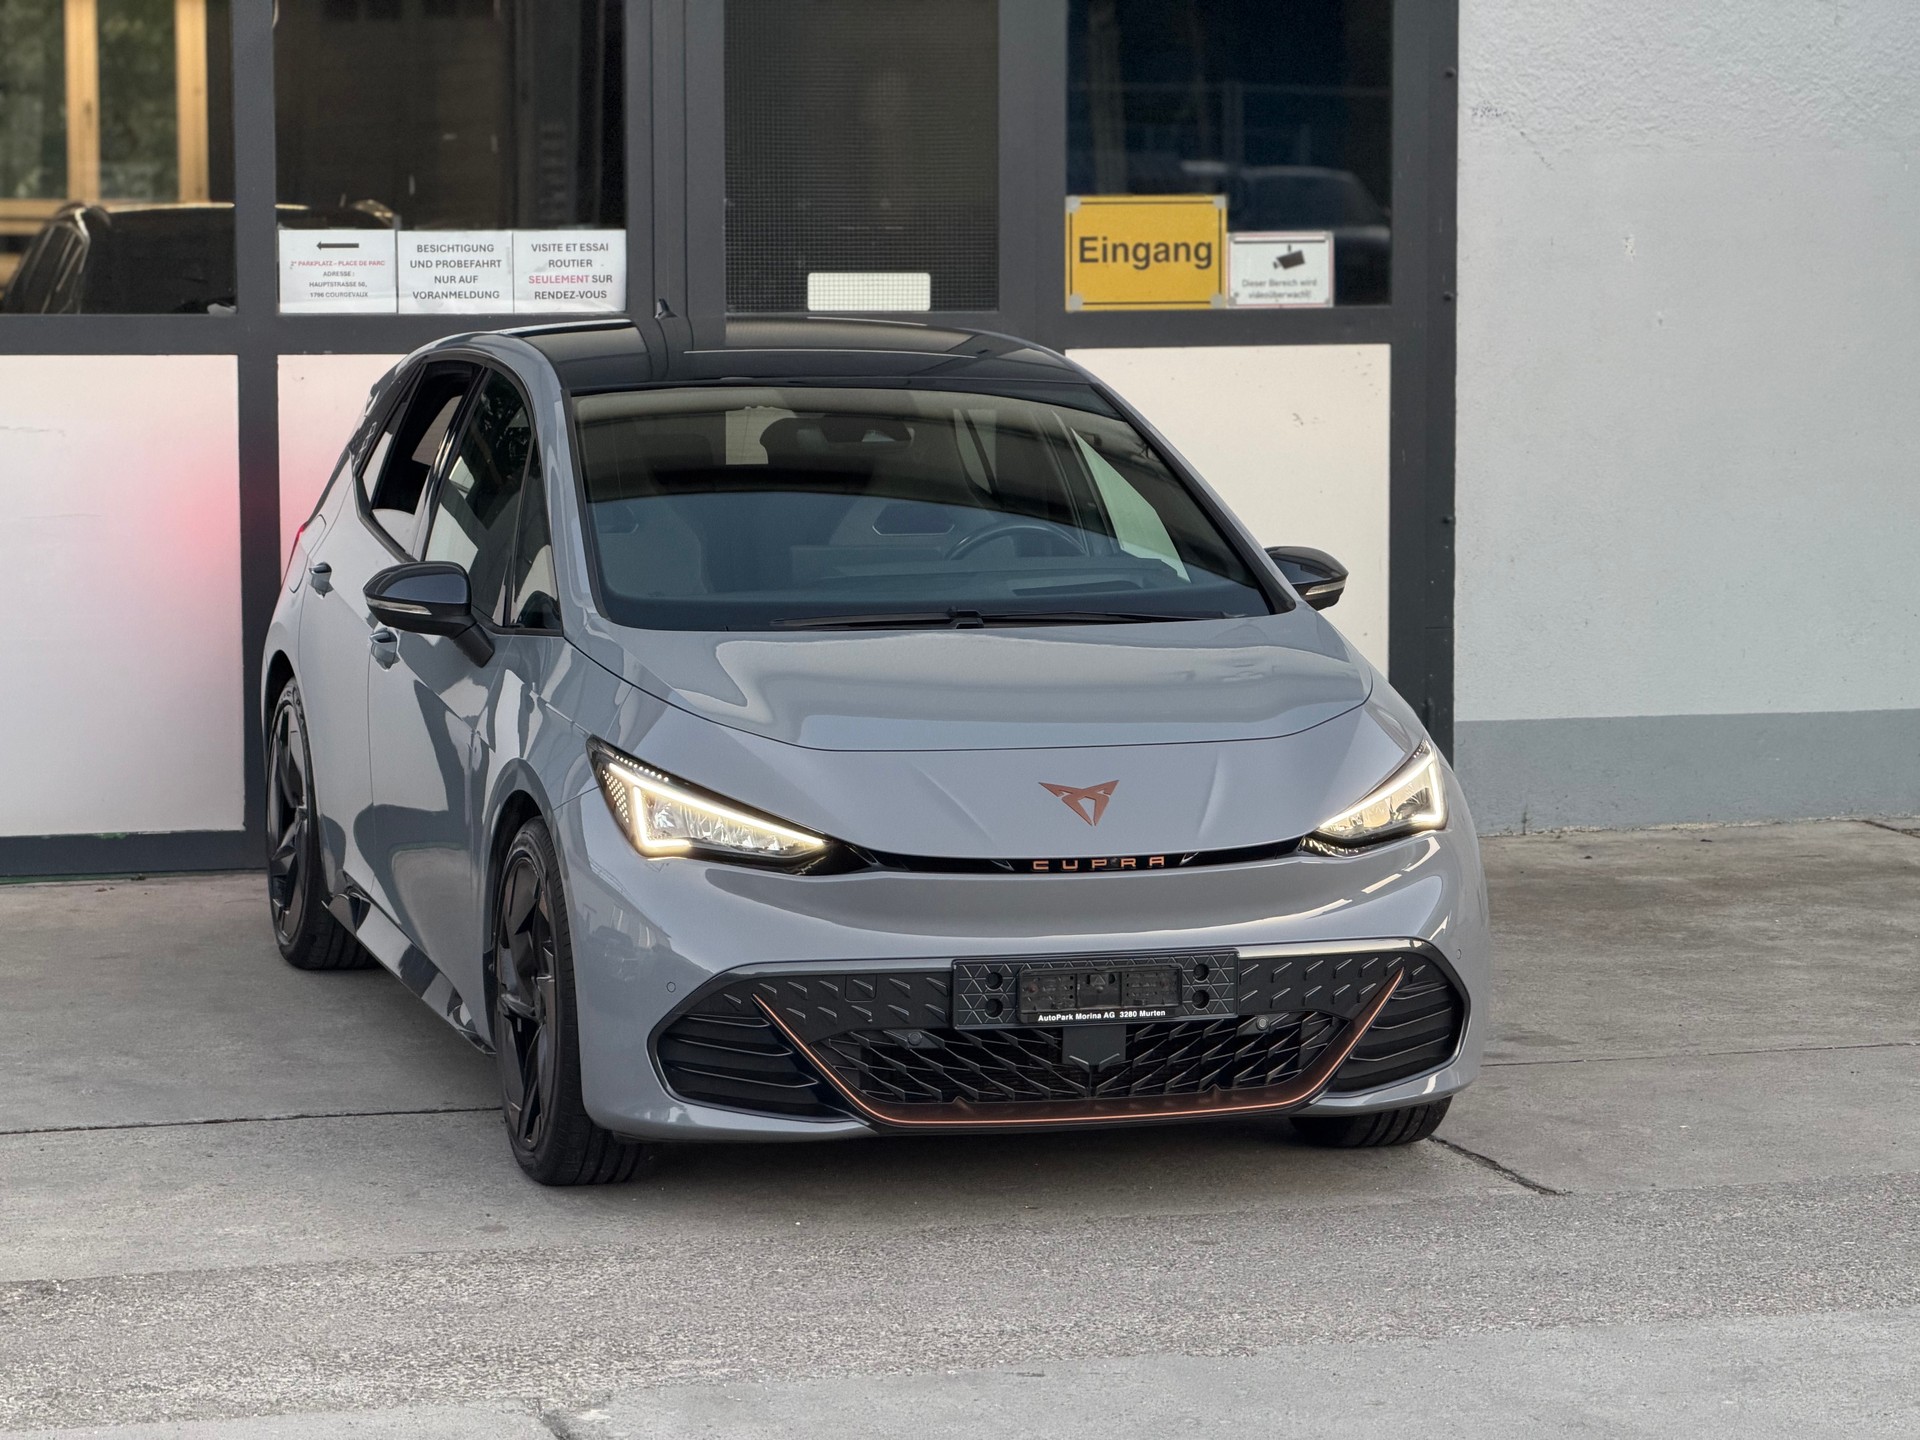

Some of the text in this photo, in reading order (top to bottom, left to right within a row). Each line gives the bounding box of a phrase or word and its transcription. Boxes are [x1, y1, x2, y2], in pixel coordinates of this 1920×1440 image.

[416, 244, 495, 253] BESICHTIGUNG
[531, 243, 609, 252] VISITE ET ESSAI
[1079, 236, 1212, 270] Eingang
[410, 259, 502, 269] UND PROBEFAHRT
[548, 259, 593, 268] ROUTIER
[434, 275, 479, 284] NUR AUF
[528, 274, 613, 284] SEULEMENT SUR
[1241, 278, 1317, 287] Dieser Bereich wird
[412, 290, 500, 299] VORANMELDUNG
[534, 290, 608, 300] RENDEZ-VOUS
[1032, 856, 1165, 870] CUPRA
[1038, 1014, 1074, 1022] AutoPark
[1103, 1011, 1116, 1019] AG
[1119, 1010, 1138, 1018] 3280
[1139, 1009, 1166, 1017] Murten
